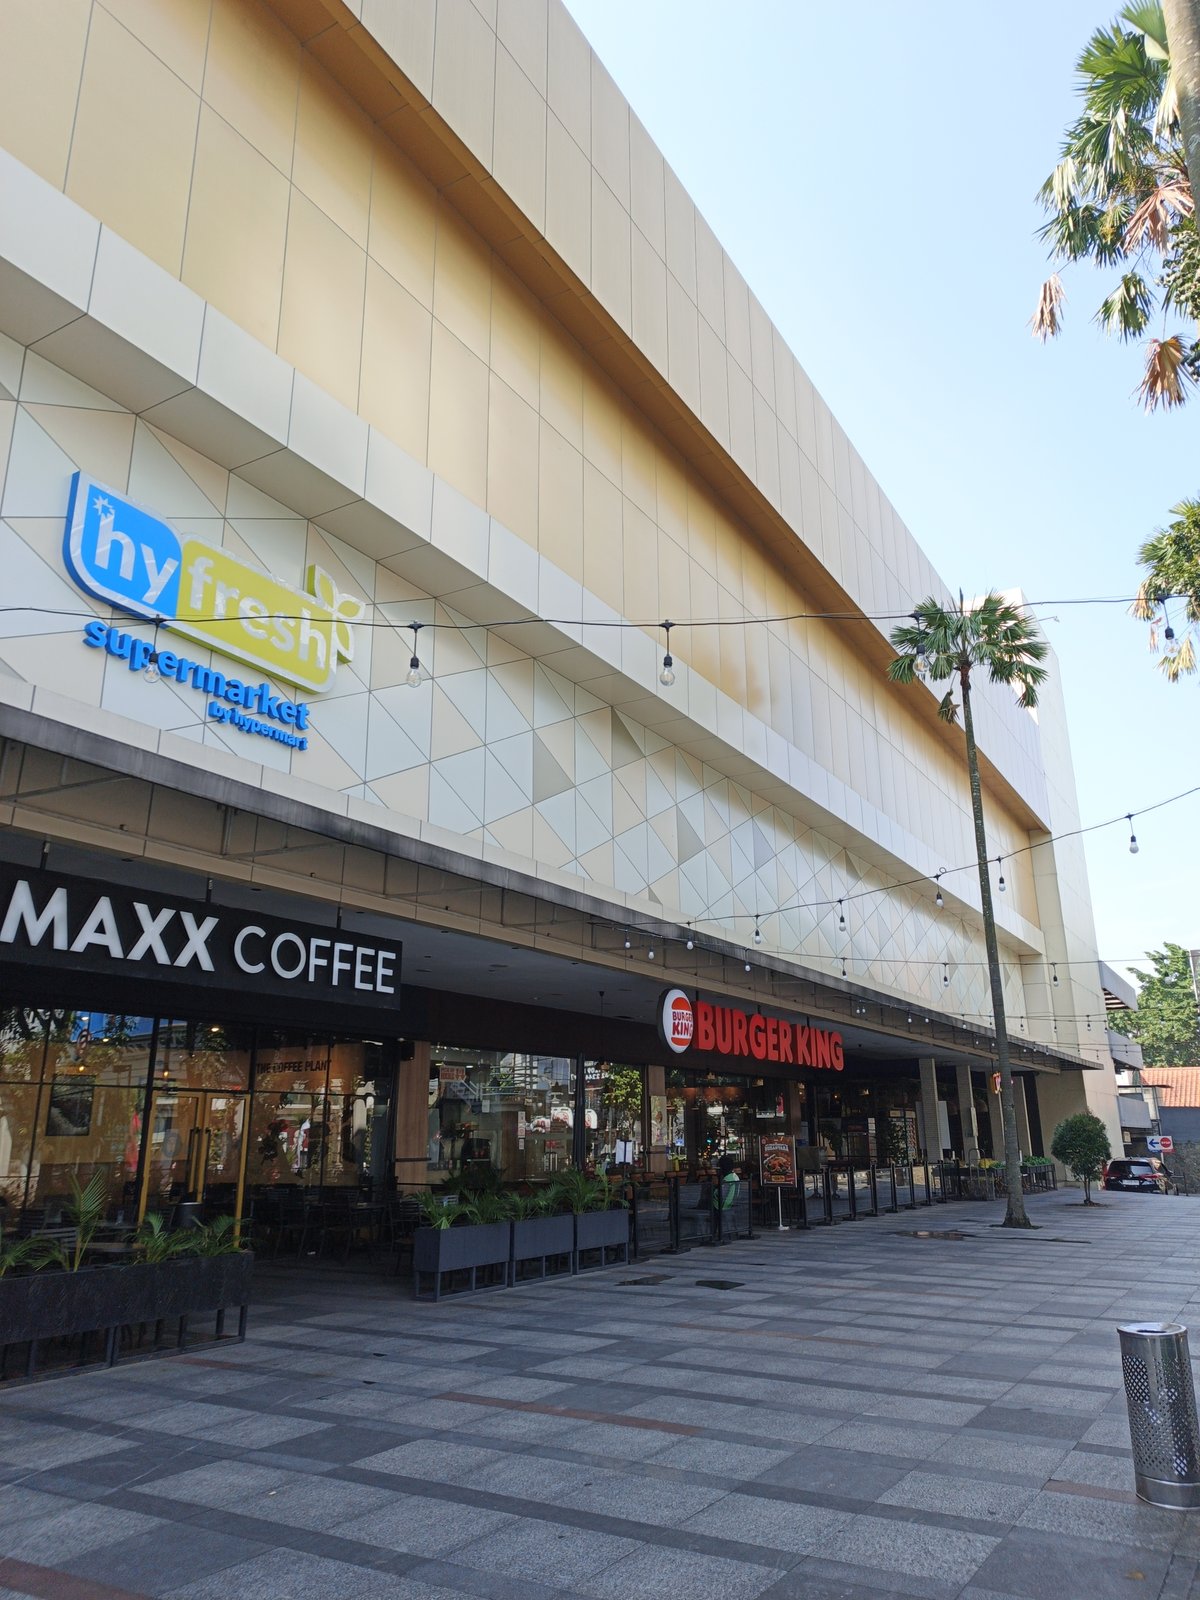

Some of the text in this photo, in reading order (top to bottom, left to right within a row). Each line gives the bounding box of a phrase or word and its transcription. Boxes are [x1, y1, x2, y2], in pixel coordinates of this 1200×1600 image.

[94, 511, 327, 670] hy fresh
[83, 620, 310, 730] supermarket
[208, 700, 308, 751] by hypermart
[0, 880, 396, 994] MAXX COFFEE
[697, 1001, 844, 1071] BURGER KING
